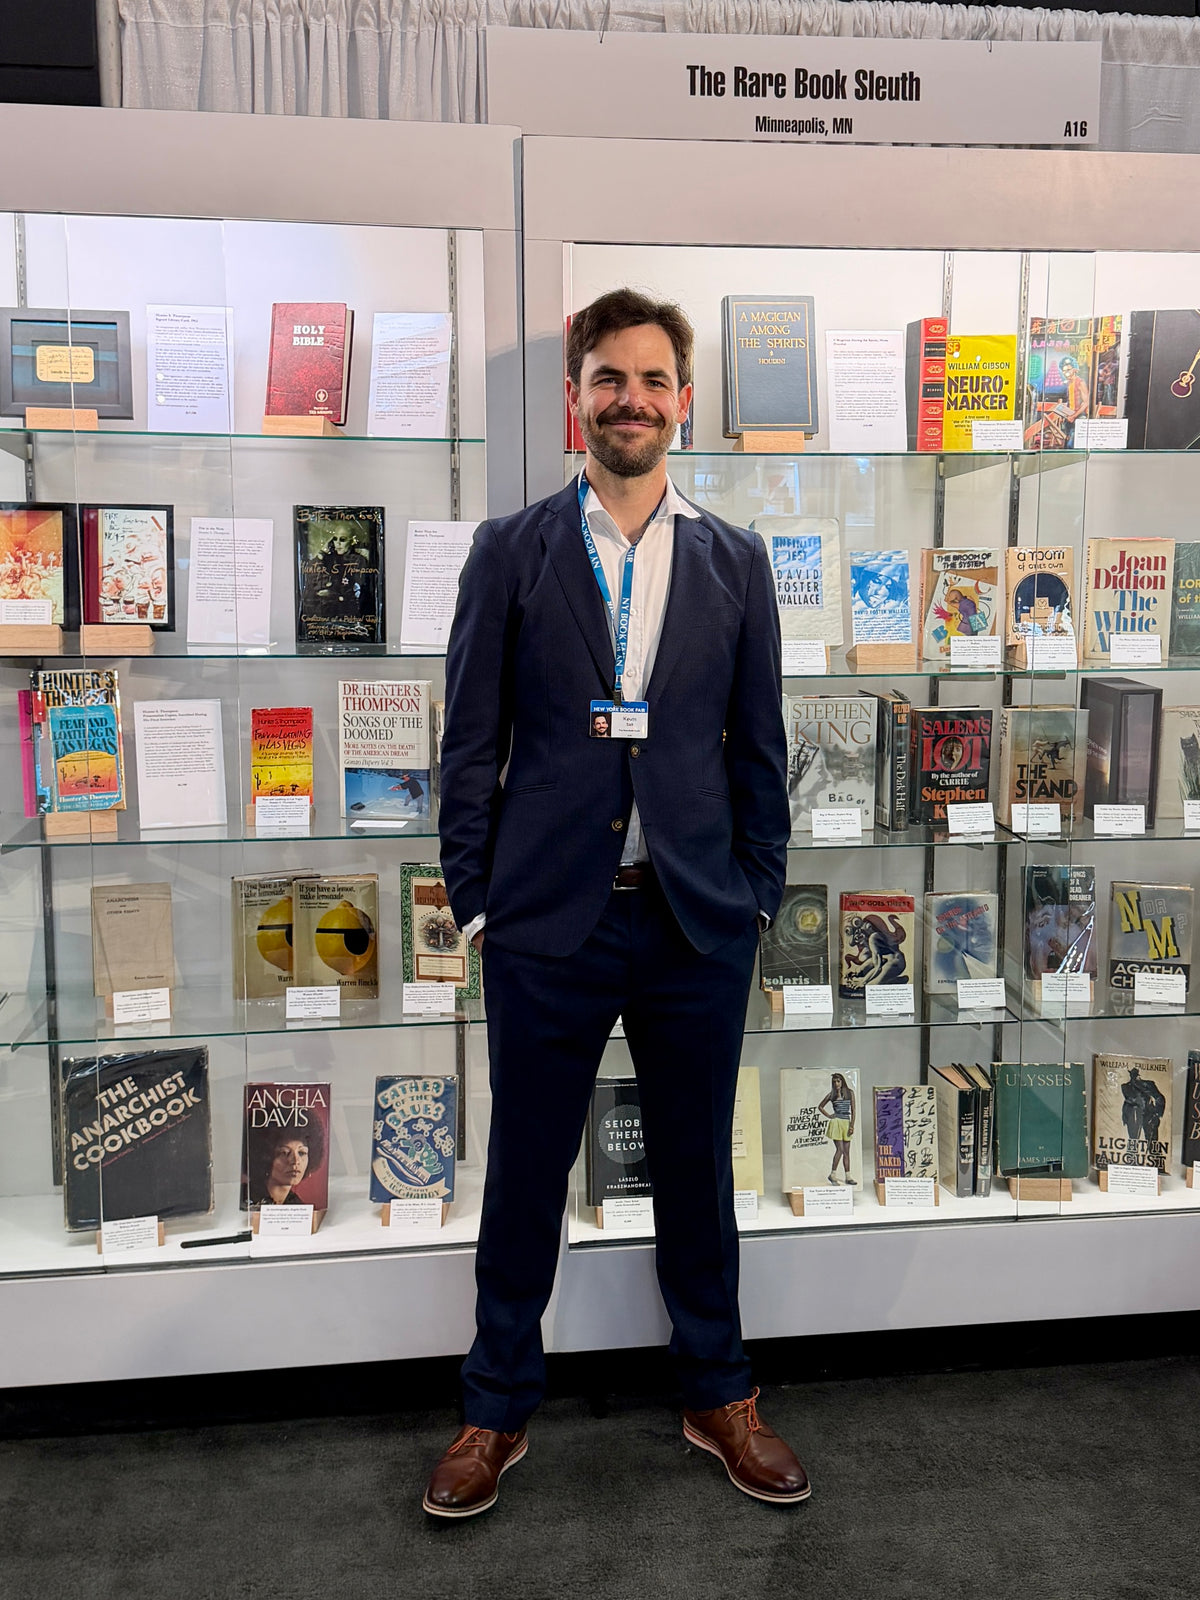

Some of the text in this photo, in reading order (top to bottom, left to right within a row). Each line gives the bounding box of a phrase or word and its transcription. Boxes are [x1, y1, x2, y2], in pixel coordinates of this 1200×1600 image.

[686, 65, 921, 102] The Rare Book Sleuth
[755, 115, 853, 136] Minneapolis, MN
[1064, 121, 1088, 137] A16
[739, 311, 801, 322] A MAGICIAN
[293, 325, 326, 335] HOLY
[750, 325, 790, 335] AMONG
[292, 336, 324, 346] BIBLE
[738, 338, 806, 349] THE SPIRITS
[982, 362, 1010, 370] GIBSON
[947, 375, 1009, 394] NEURO-
[946, 394, 1008, 411] MANCER
[787, 551, 807, 561] JEST
[1111, 551, 1166, 574] Joan
[958, 561, 985, 569] SYSTEM
[777, 569, 819, 579] DAVID
[1094, 568, 1165, 590] Didion
[778, 582, 819, 592] FOSTER
[778, 594, 820, 605] WALLACE
[1114, 591, 1158, 611] The
[1179, 594, 1191, 603] of
[620, 598, 629, 639] NY BOOK
[1094, 611, 1157, 632] White
[43, 671, 114, 690] HUNTER S
[343, 684, 421, 696] DR. HUNTER S.
[343, 697, 420, 712] THOMPSON
[793, 704, 872, 719] STEPHEN
[59, 717, 108, 730] FEAR AND
[343, 713, 422, 728] SONGS OF THE
[53, 726, 115, 740] LOATHING IN
[344, 729, 393, 740] DOOMED
[794, 721, 872, 744] KING
[54, 738, 118, 756] LAS VEGAS
[921, 735, 989, 772] LOT
[1017, 764, 1047, 780] THE
[921, 786, 985, 803] Stephen
[1016, 779, 1078, 798] STAND
[829, 793, 853, 802] BAG
[259, 881, 272, 889] have
[317, 884, 330, 892] have
[258, 889, 285, 897] lemonade
[1116, 890, 1167, 934] N OR
[1142, 916, 1180, 960] M
[1114, 963, 1185, 975] AGATHA
[766, 976, 810, 985] solaris
[1101, 1060, 1167, 1072] WILLIAM FAULKNER
[1006, 1074, 1072, 1086] ULYSSES
[95, 1075, 139, 1109] THE
[248, 1088, 327, 1109] ANGELA
[379, 1079, 443, 1106] FATHER
[395, 1099, 405, 1108] OF
[70, 1070, 187, 1151] ANARCHIST
[388, 1103, 441, 1126] BLUES
[800, 1107, 817, 1115] FAST
[251, 1107, 309, 1128] DAVIS
[789, 1114, 821, 1124] TIMES AT
[73, 1086, 202, 1171] COOKBOOK
[787, 1120, 828, 1132] RIDGEMONT
[808, 1128, 826, 1136] HIGH
[879, 1146, 893, 1155] THE
[1099, 1137, 1168, 1154] LIGHT IN
[879, 1157, 901, 1166] NAKED
[1097, 1151, 1166, 1168] AUGUST
[879, 1169, 901, 1178] LUNCH
[405, 1189, 440, 1199] HANDY
